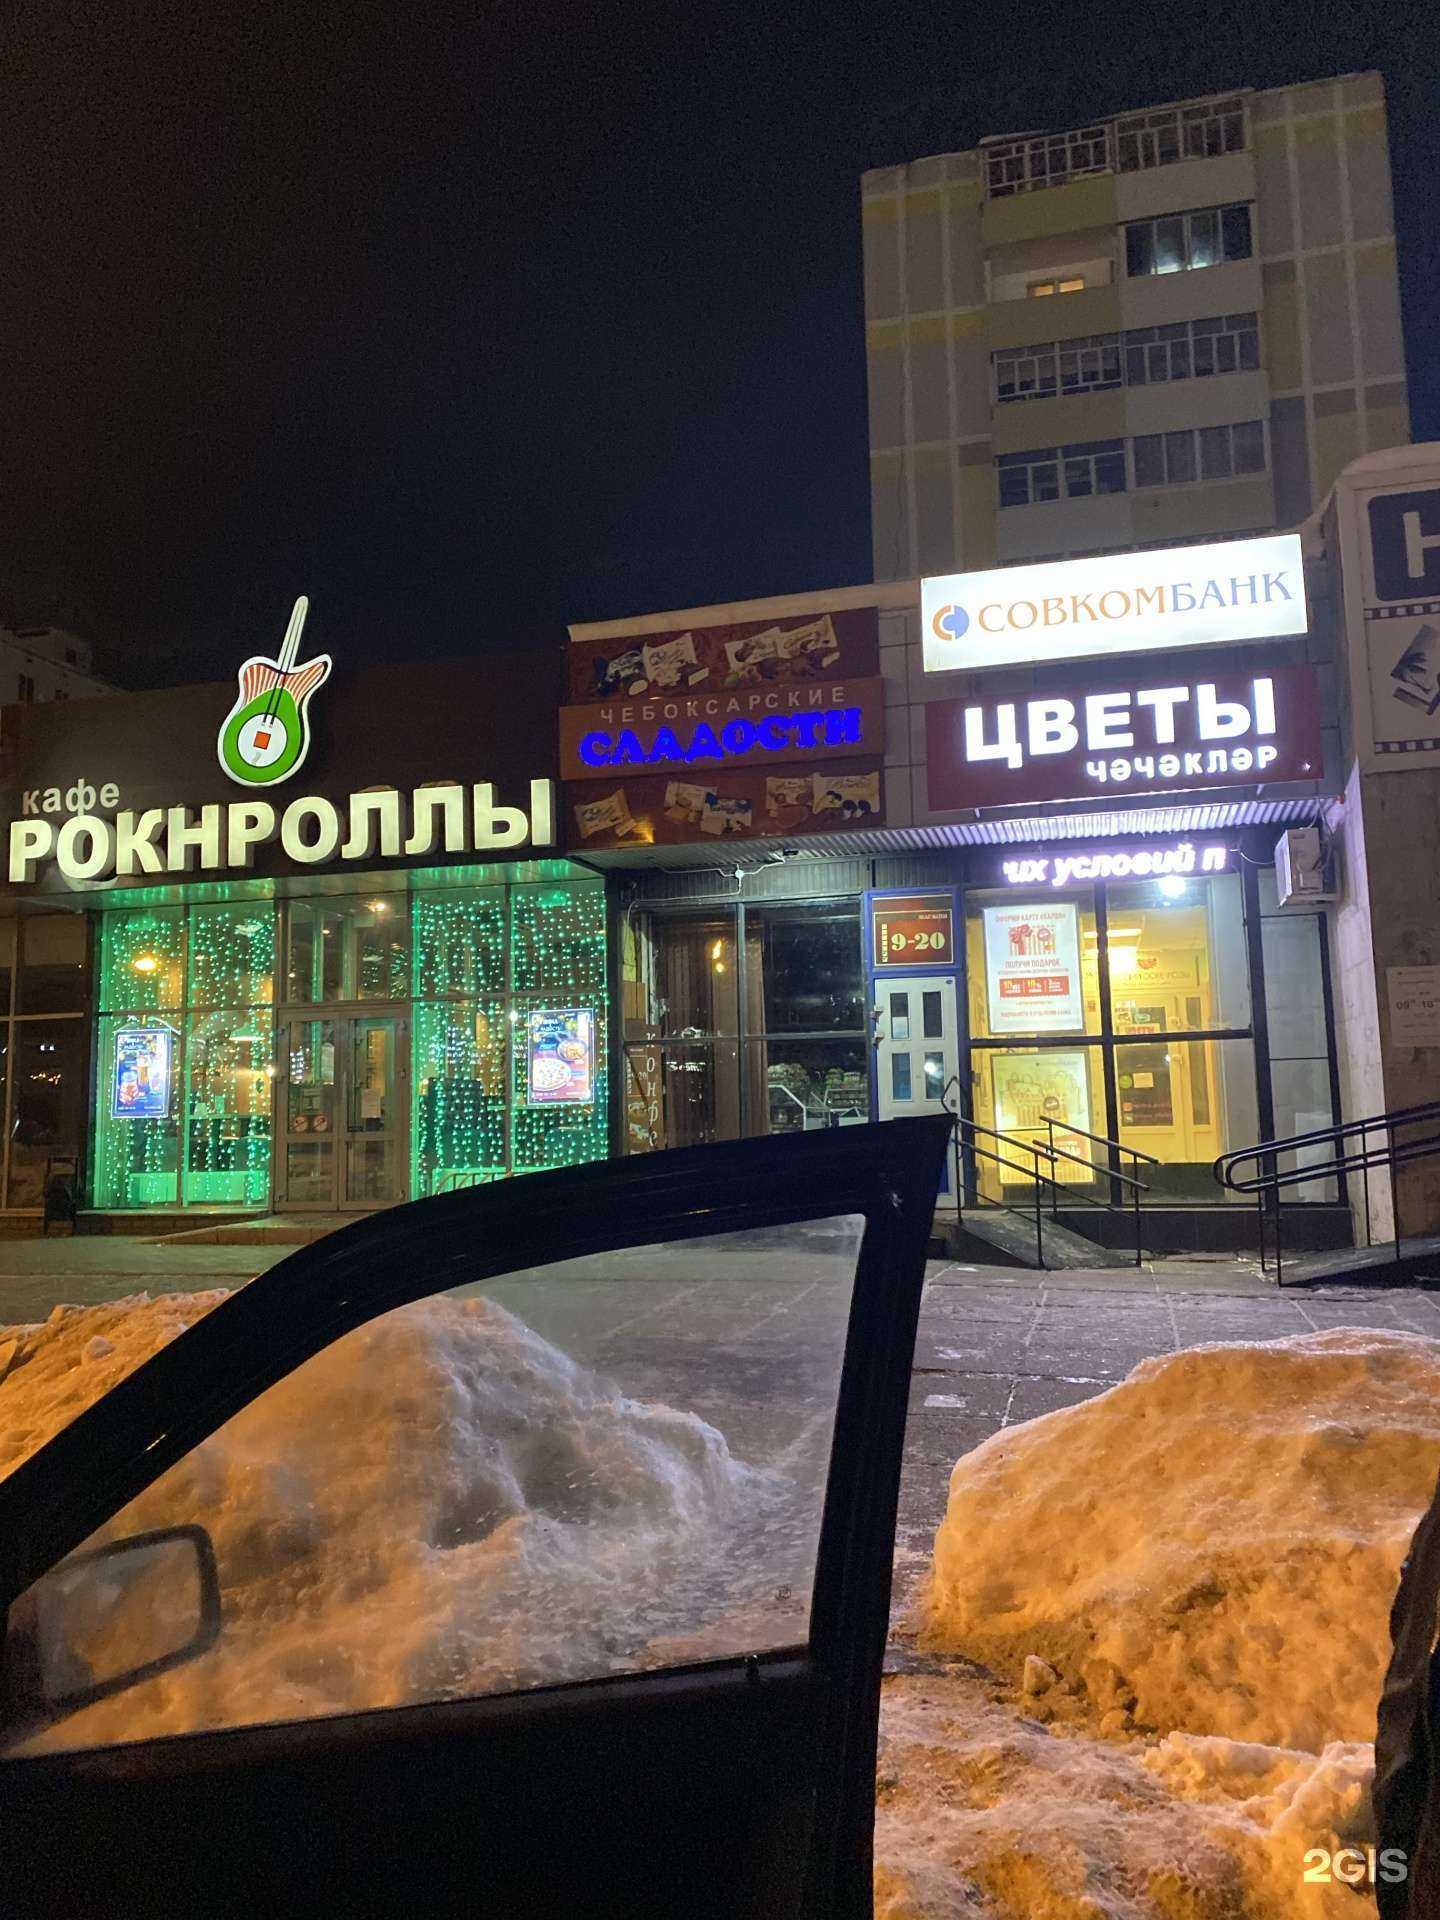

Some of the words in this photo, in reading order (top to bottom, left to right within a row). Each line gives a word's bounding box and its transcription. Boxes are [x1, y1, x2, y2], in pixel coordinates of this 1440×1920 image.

[978, 571, 1292, 633] СОВКОМБАНК
[600, 686, 845, 724] ЧЕБОКСАРСКИЕ
[965, 678, 1277, 769] ЦВЕТЫ
[579, 707, 863, 767] СЛАДОСТИ
[22, 778, 120, 815] кафе
[9, 778, 552, 882] РОКНРОЛЛЫ
[1002, 859, 1049, 883] их
[1051, 842, 1196, 886] условий
[891, 931, 946, 951] 9-20
